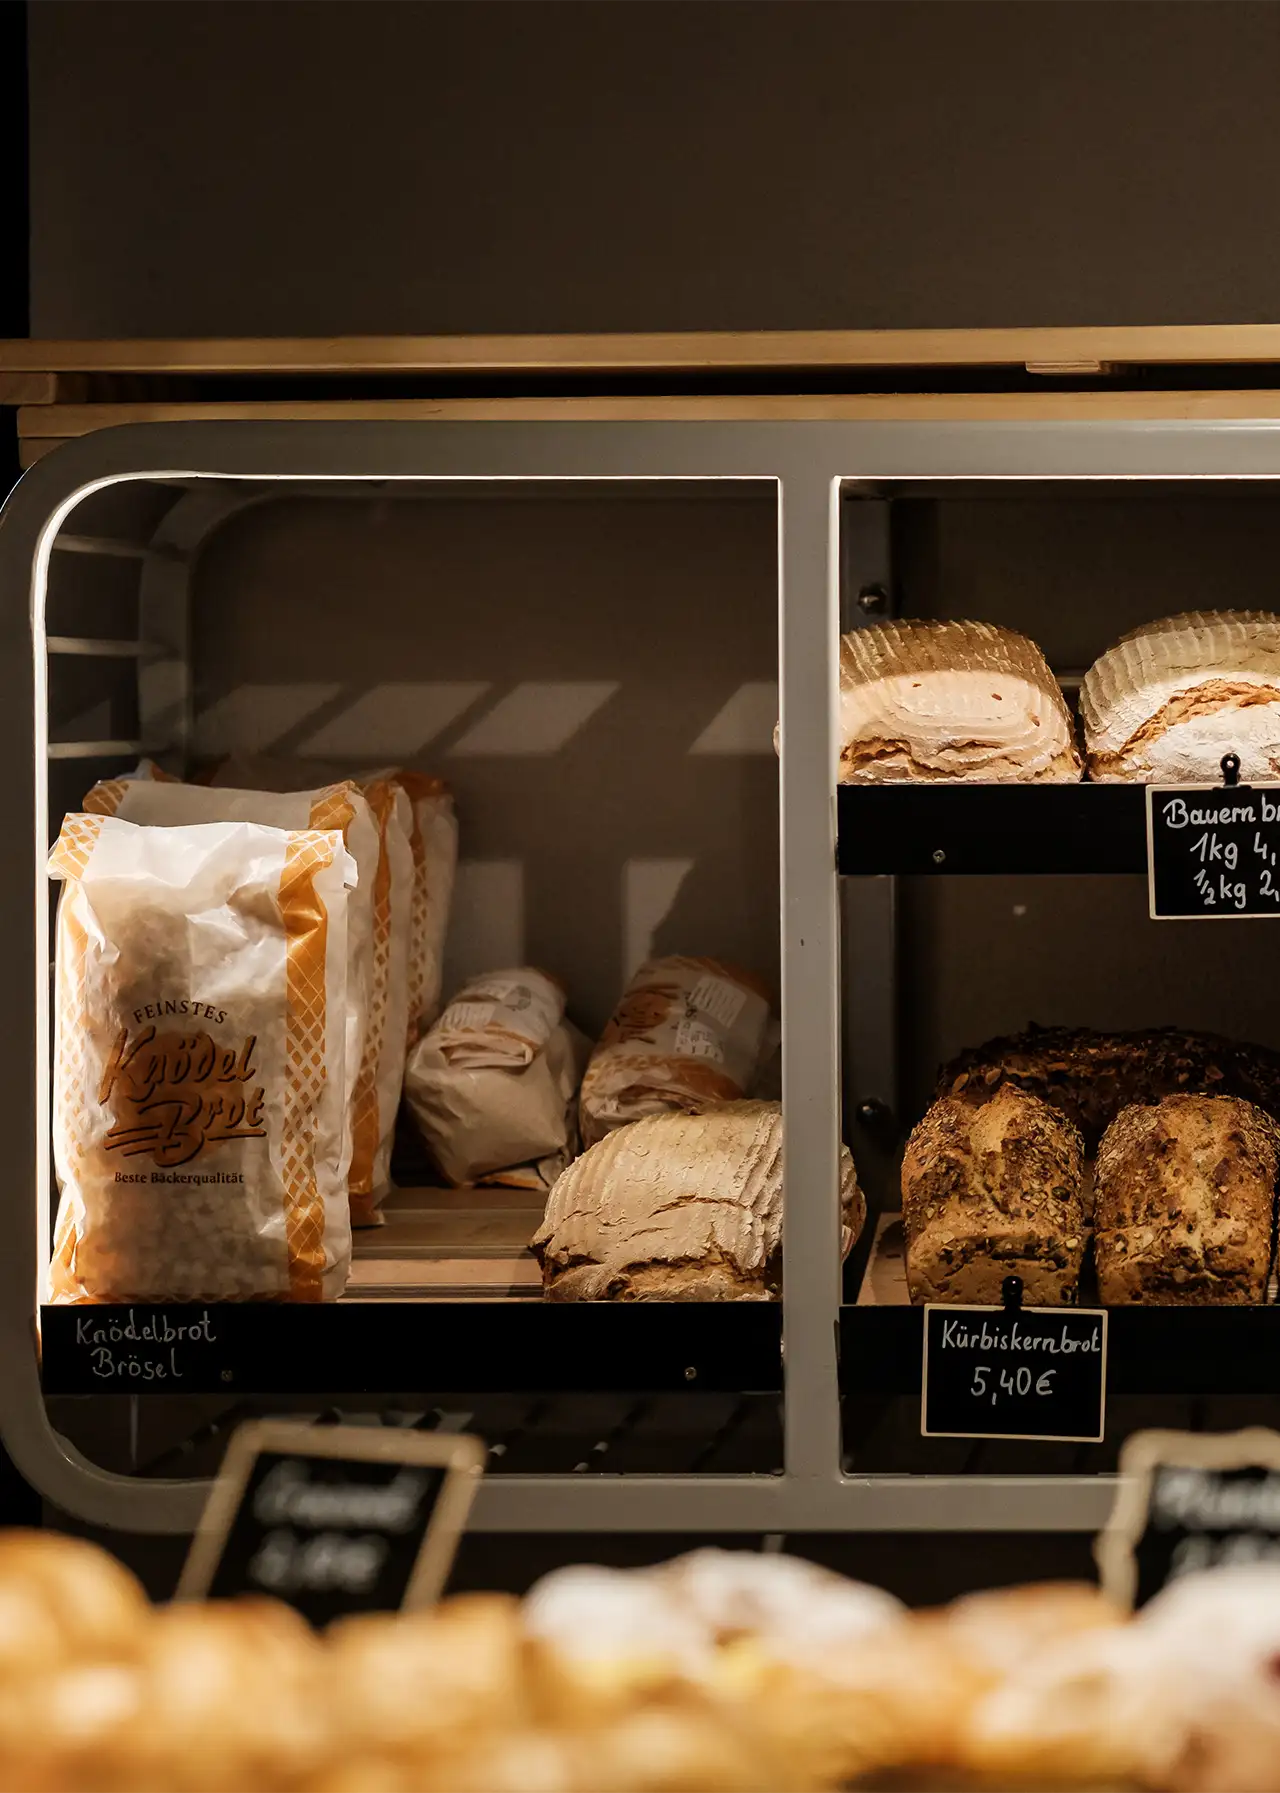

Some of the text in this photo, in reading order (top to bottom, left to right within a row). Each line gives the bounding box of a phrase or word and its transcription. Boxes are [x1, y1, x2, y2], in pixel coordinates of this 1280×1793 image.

[1189, 832, 1238, 870] 1kg
[132, 1000, 228, 1024] FEINSTES
[98, 1025, 257, 1107] Knödel
[106, 1088, 267, 1168] Brot
[115, 1171, 244, 1186] Beste Bäckerqualität
[76, 1309, 217, 1344] Knödelbrot
[942, 1320, 1101, 1353] Kürbiskernbrot
[90, 1347, 183, 1380] Brösel
[971, 1366, 1057, 1405] 5,40€
